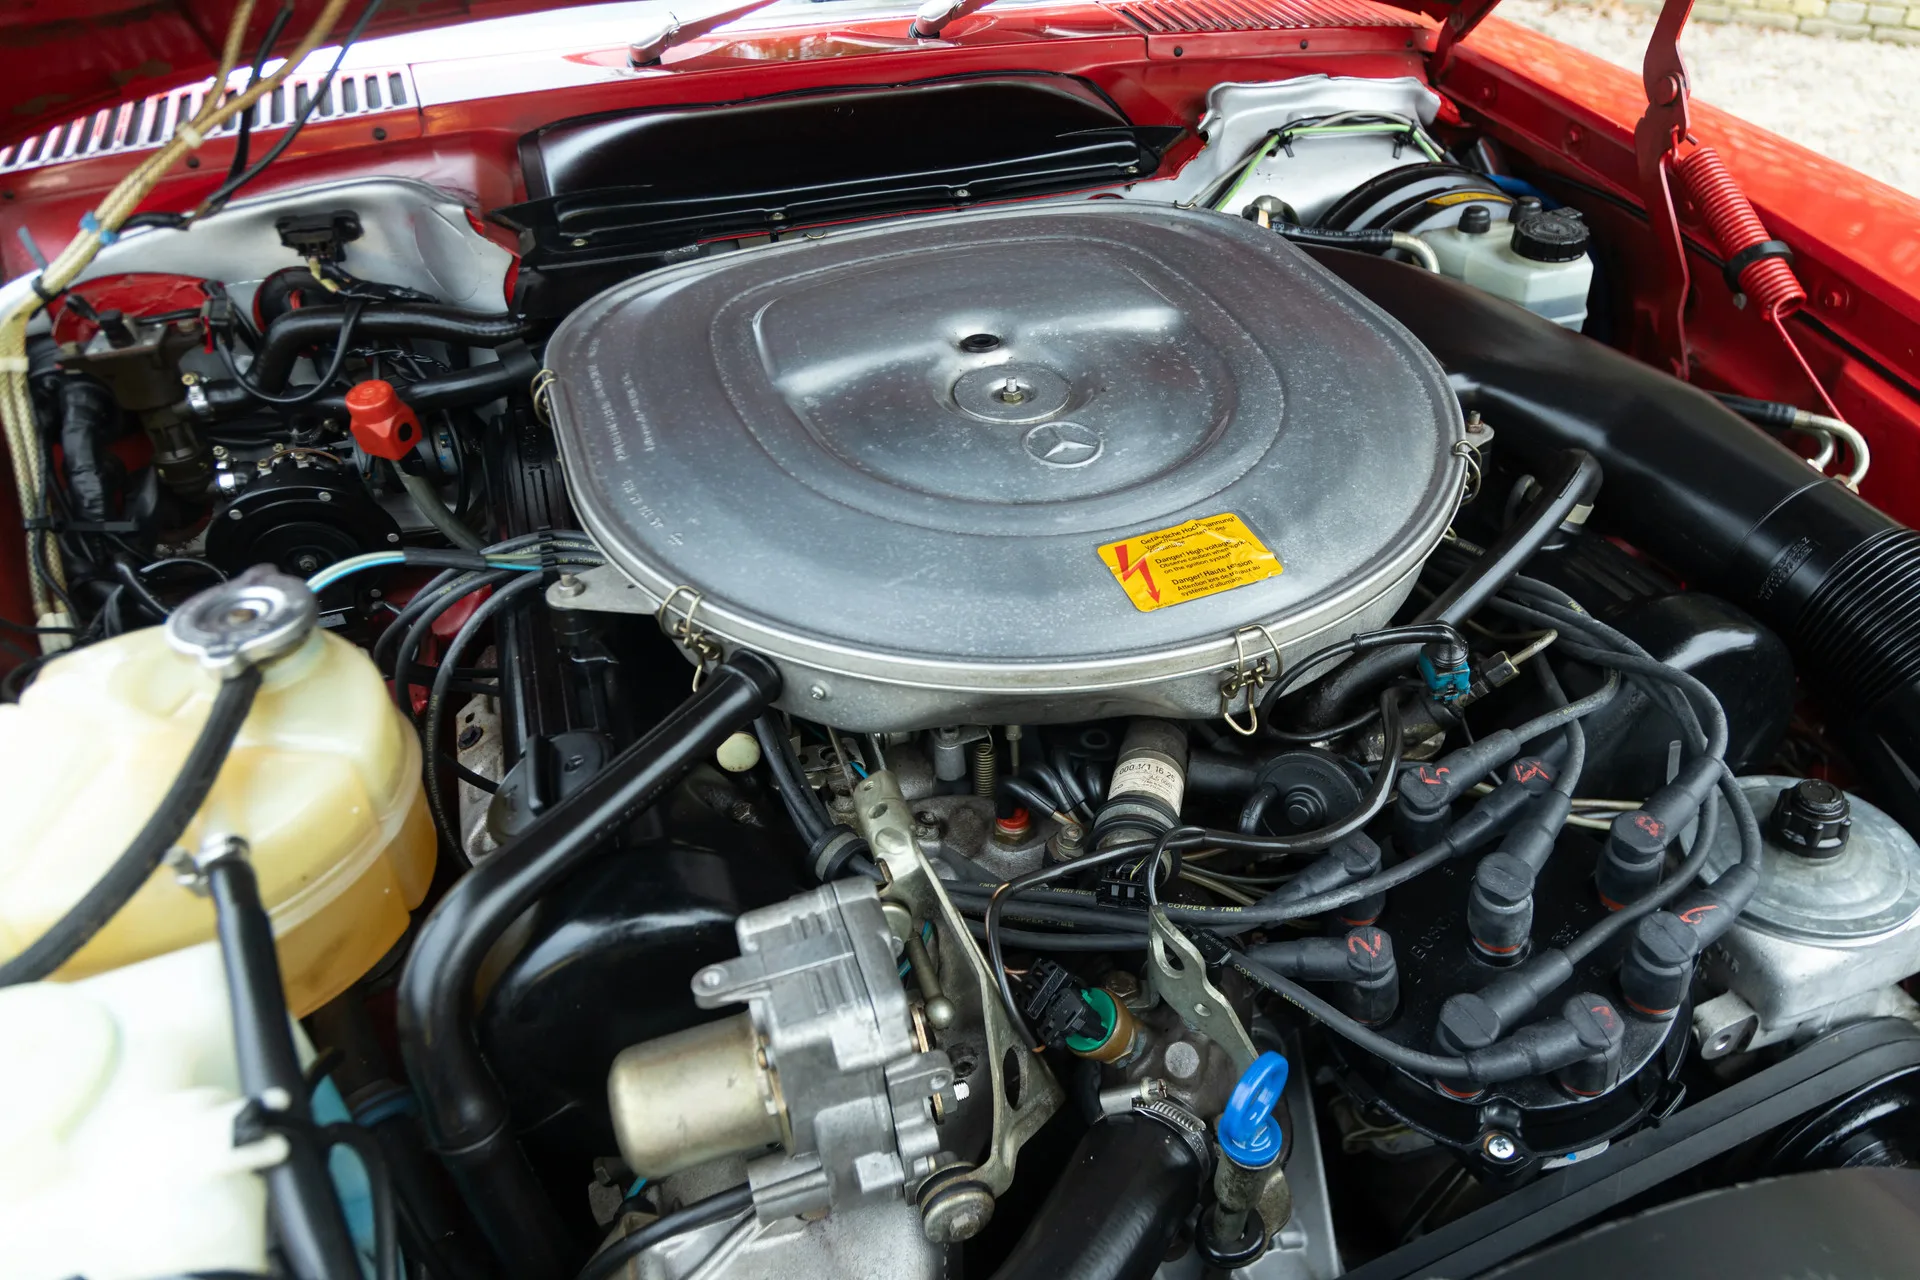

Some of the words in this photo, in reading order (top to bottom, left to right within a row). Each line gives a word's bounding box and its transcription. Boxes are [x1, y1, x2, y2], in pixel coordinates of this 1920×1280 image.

[1155, 551, 1185, 564] Danger!
[1186, 548, 1205, 556] High
[1204, 541, 1230, 551] voltage
[1160, 559, 1187, 568] Observe
[1188, 553, 1211, 561] caution
[1186, 559, 1208, 568] ignition
[1209, 552, 1231, 562] system
[1171, 572, 1202, 585] Danger!
[1203, 567, 1226, 577] Haute
[1177, 580, 1207, 591] Attention
[426, 720, 435, 753] COPPER
[1155, 765, 1164, 774] 16
[1167, 902, 1207, 912] COPPER
[1348, 934, 1382, 958] 2
[1234, 963, 1270, 989] COPPER
[1283, 993, 1305, 1010] HIGH
